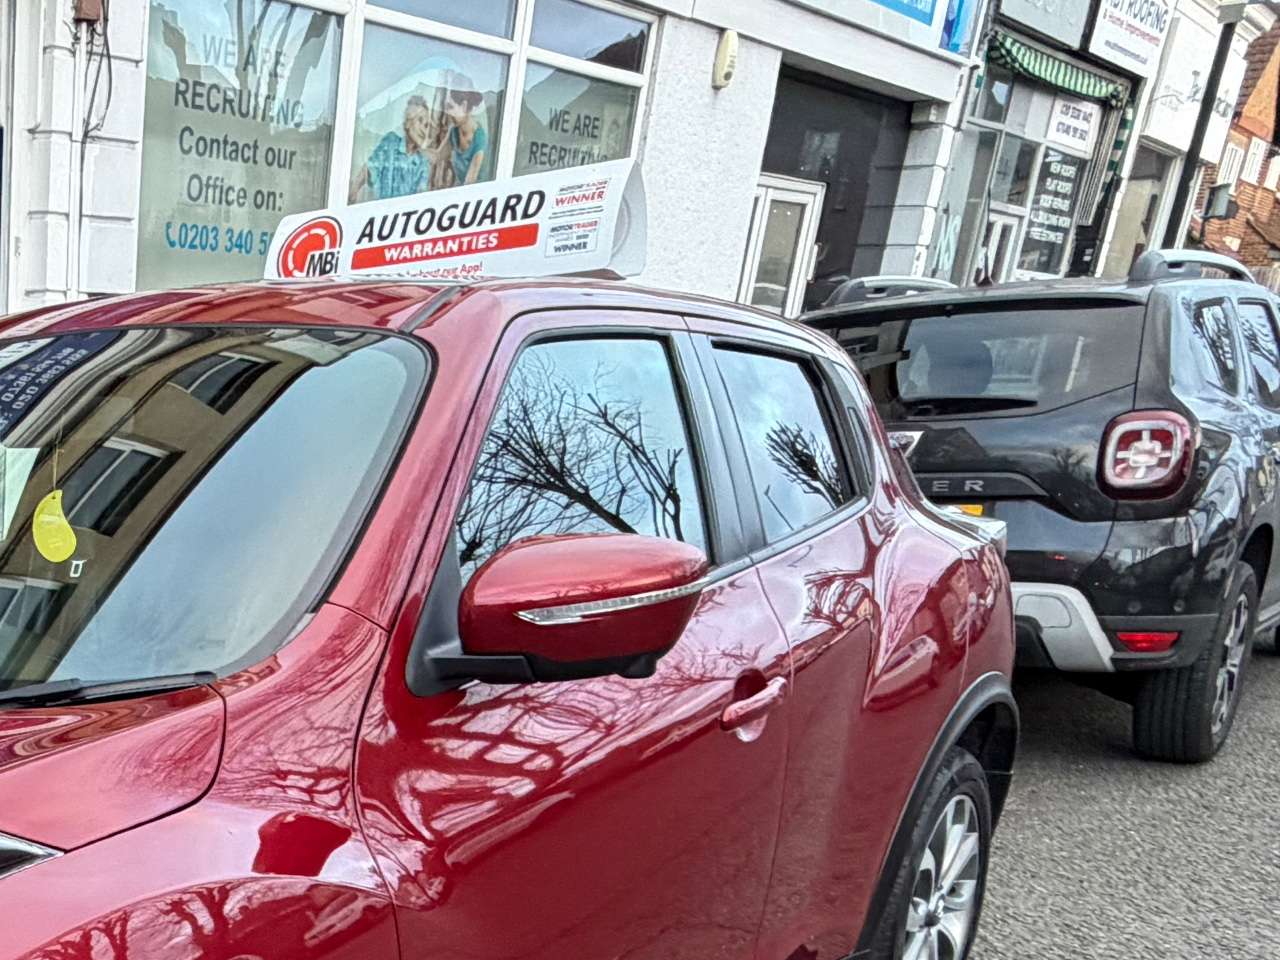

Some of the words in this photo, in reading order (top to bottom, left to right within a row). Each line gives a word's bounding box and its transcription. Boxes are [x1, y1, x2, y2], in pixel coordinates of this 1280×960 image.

[203, 35, 236, 68] WE
[548, 108, 570, 133] WE
[572, 113, 600, 139] ARE
[179, 126, 259, 166] Contact
[265, 146, 297, 171] our
[187, 173, 247, 207] Office
[253, 189, 284, 212] on:
[555, 191, 605, 207] WINNER
[356, 189, 546, 245] AUTOGUARD
[178, 222, 219, 251] 0203
[225, 229, 253, 255] 340
[383, 233, 498, 262] WARRANTIES
[307, 250, 340, 275] MBi
